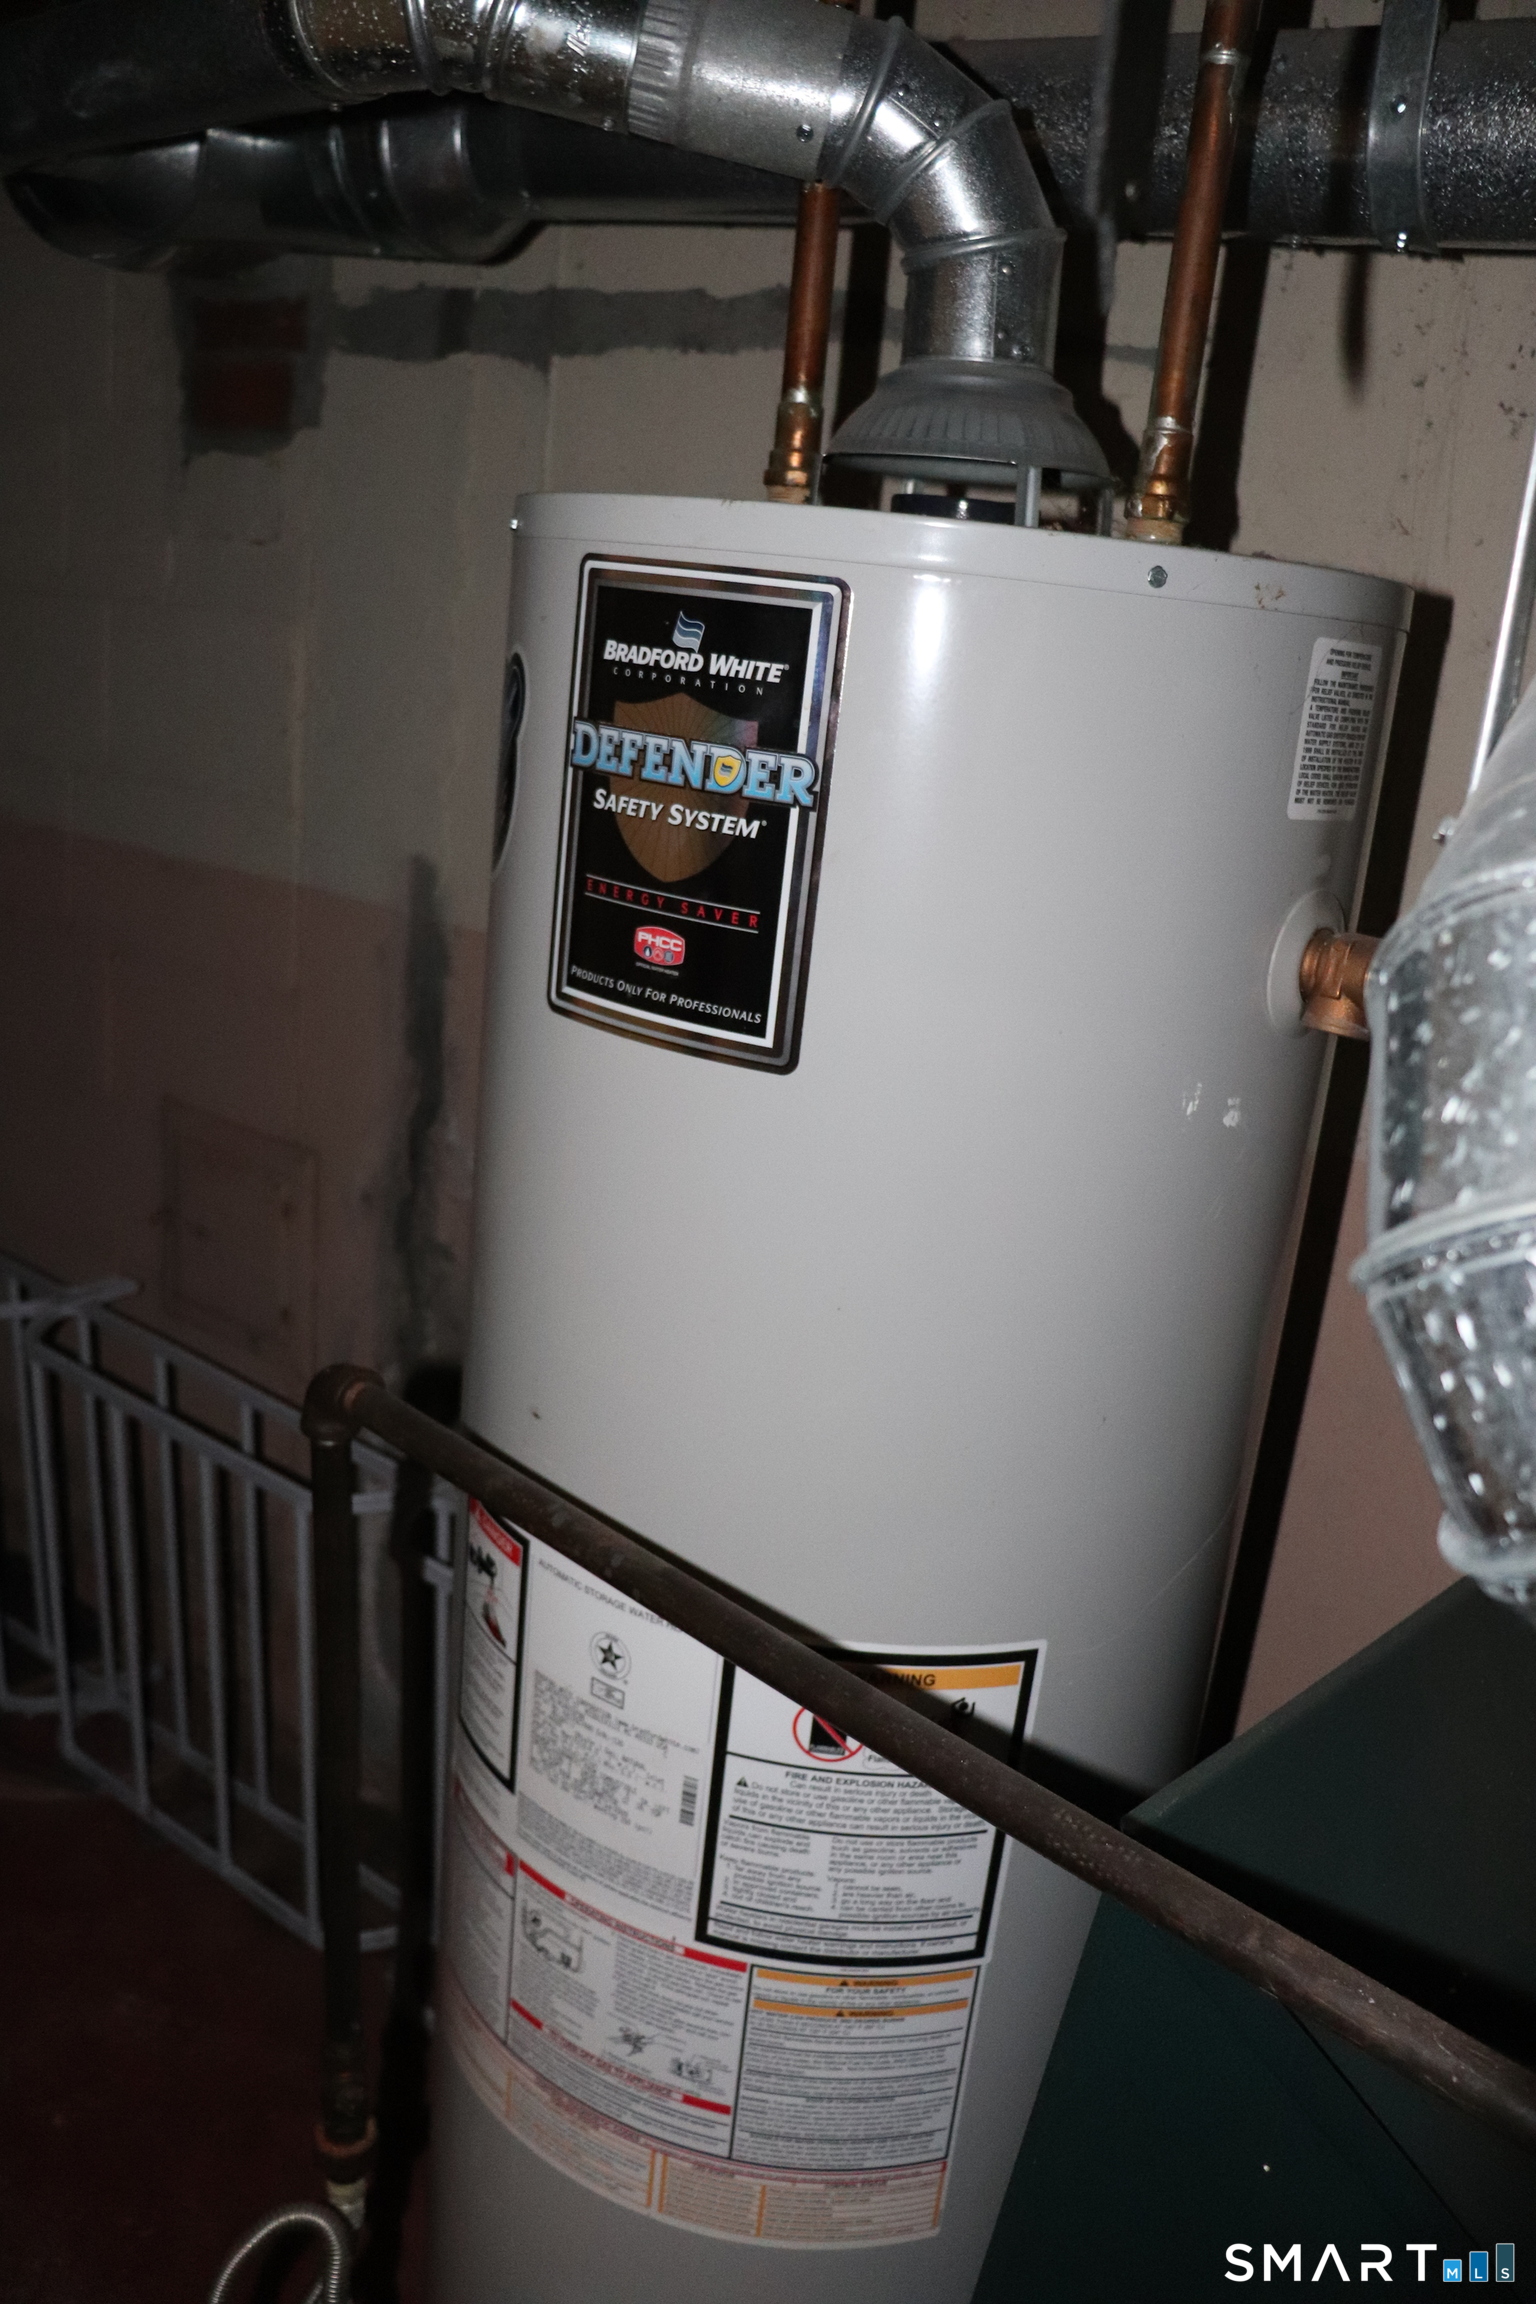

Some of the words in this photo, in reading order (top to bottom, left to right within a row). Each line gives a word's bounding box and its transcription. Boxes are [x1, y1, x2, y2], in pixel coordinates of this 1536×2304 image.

[603, 639, 704, 673] BRADFORD
[613, 666, 764, 697] CORPORATION
[571, 717, 819, 808] DEFENDER
[593, 788, 664, 821] SAFETY
[586, 878, 665, 909] ENERGY
[681, 902, 758, 928] SAVER
[638, 931, 683, 952] PHCC
[669, 994, 762, 1024] PROFESSIONALS
[785, 1771, 807, 1780] FIRE
[810, 1775, 833, 1784] AND
[836, 1778, 894, 1788] EXPLOSION
[897, 1780, 928, 1789] HAZA
